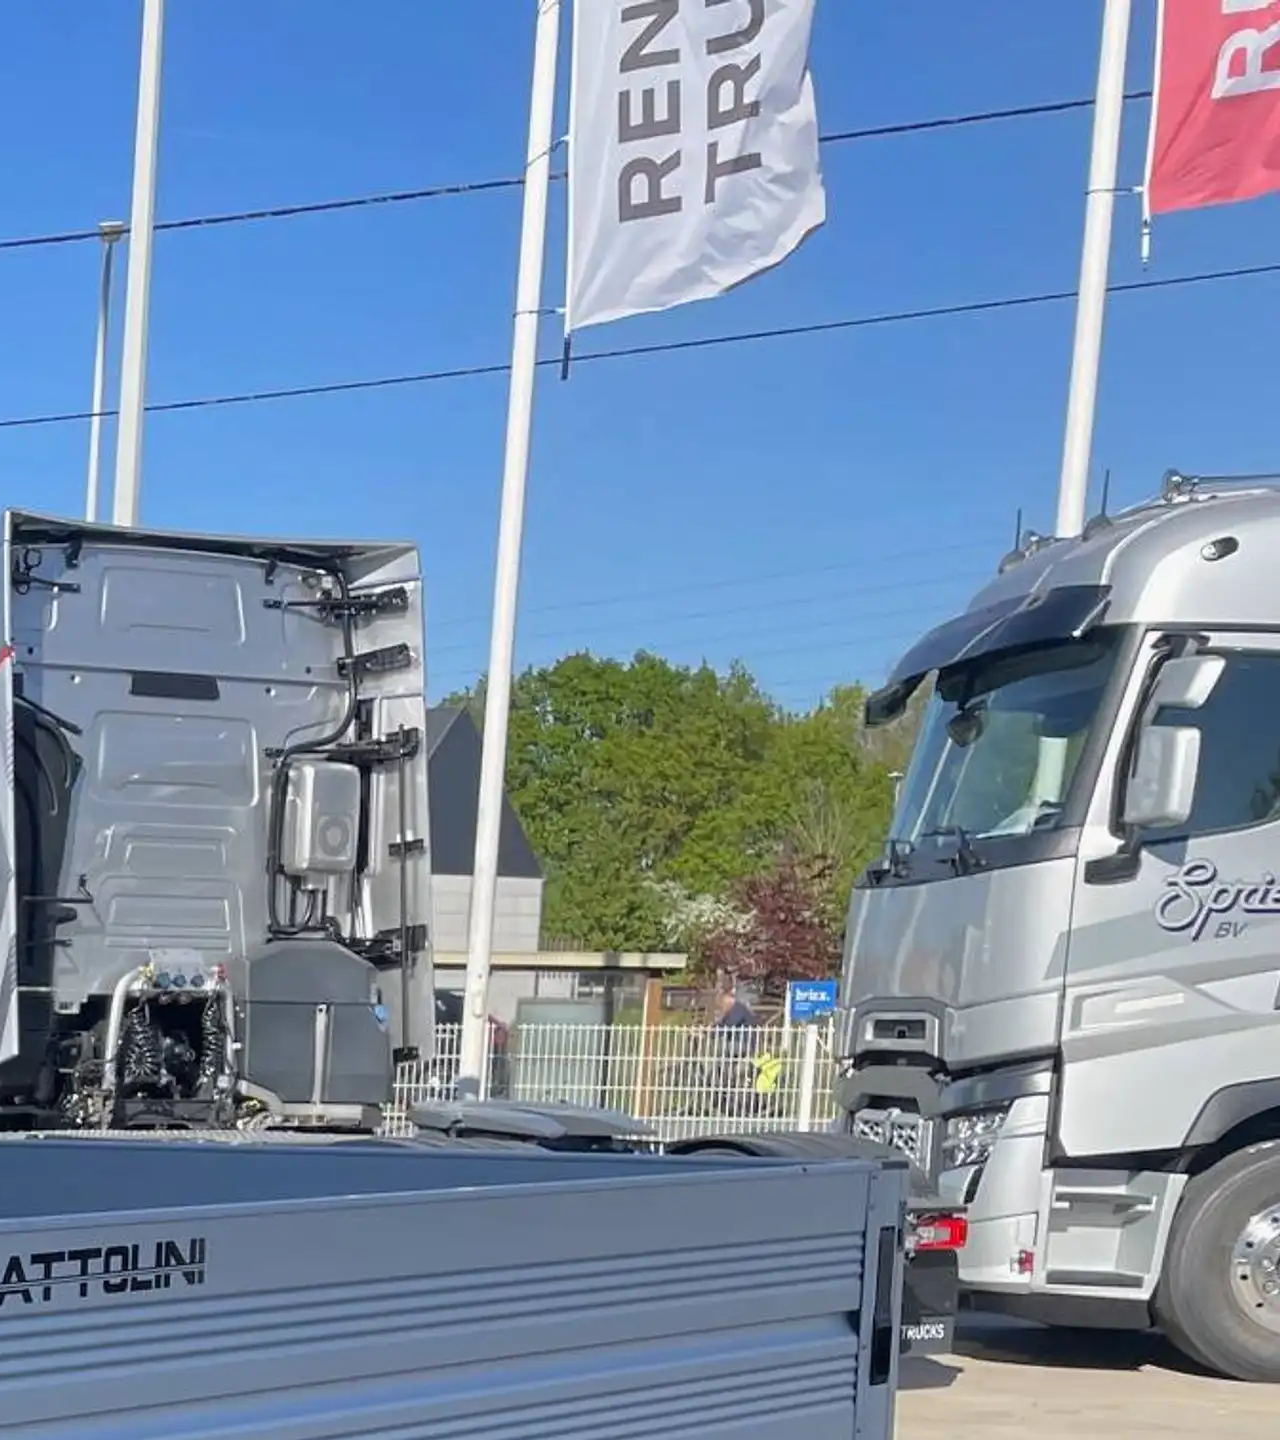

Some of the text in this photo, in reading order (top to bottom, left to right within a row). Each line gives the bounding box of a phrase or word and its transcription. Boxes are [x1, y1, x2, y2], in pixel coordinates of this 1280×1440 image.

[704, 0, 765, 205] TRU
[1214, 922, 1249, 939] BV
[901, 1323, 945, 1340] TRUCKS
